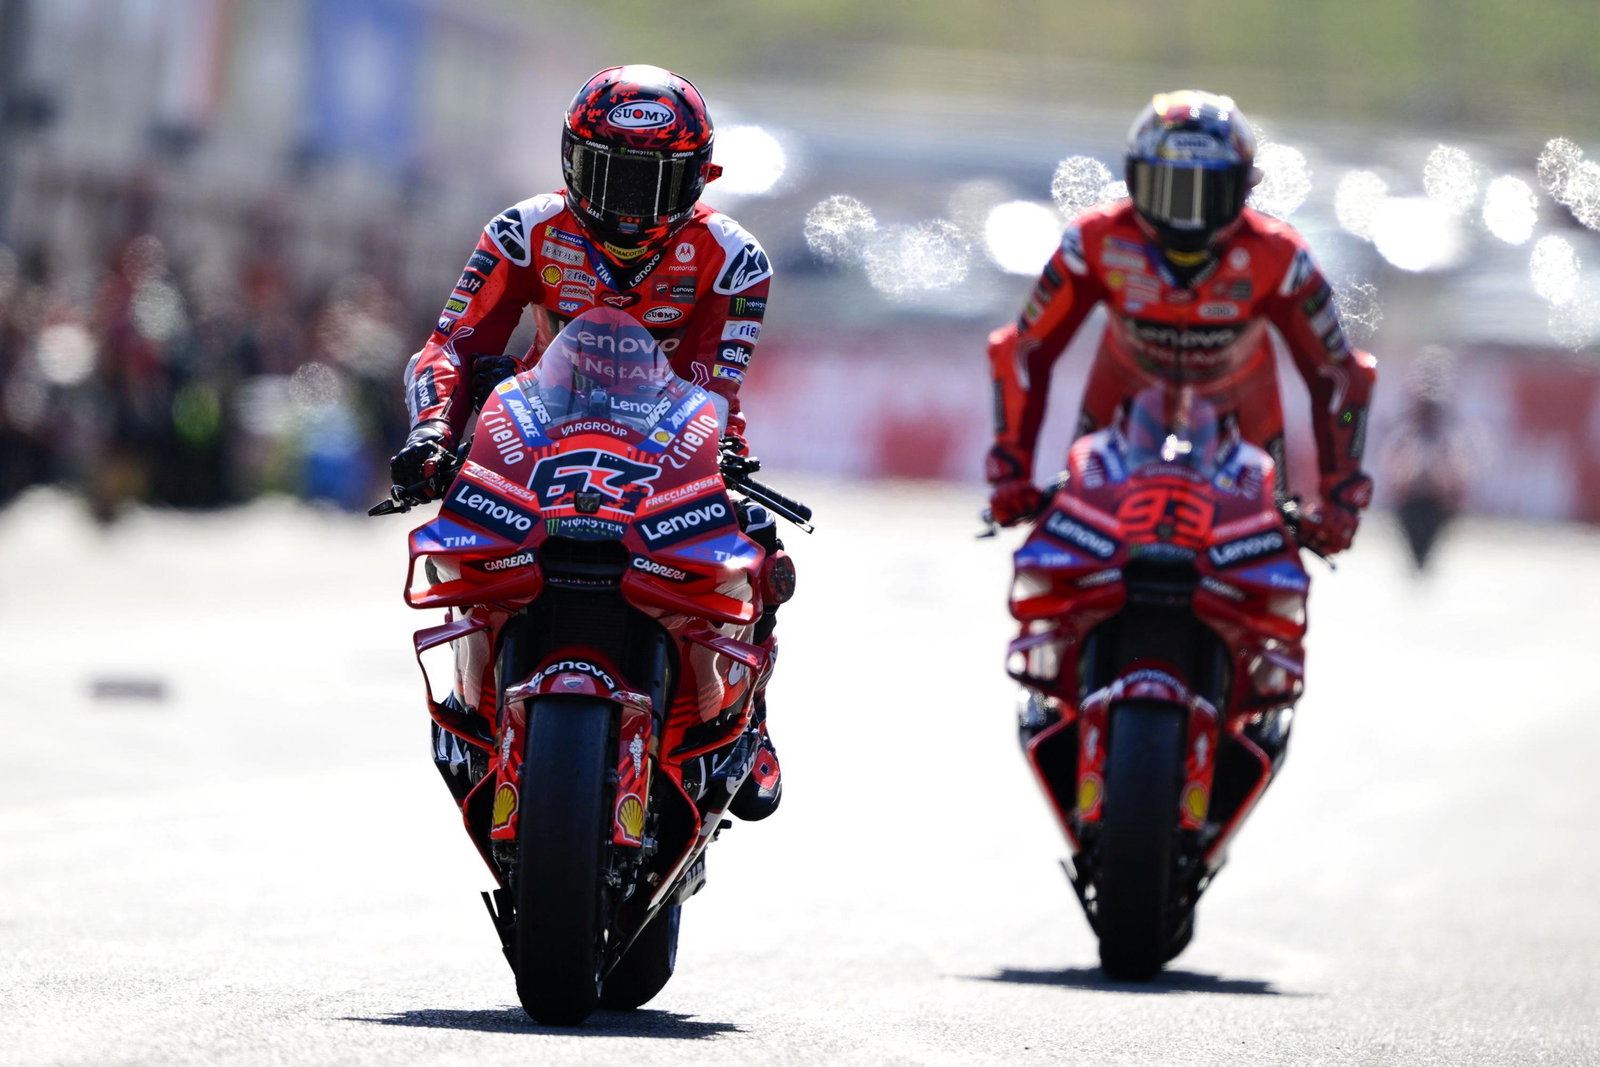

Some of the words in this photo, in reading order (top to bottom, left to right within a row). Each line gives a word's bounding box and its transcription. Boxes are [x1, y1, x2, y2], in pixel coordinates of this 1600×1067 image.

[615, 108, 669, 123] SUOMY
[585, 139, 609, 150] CARRERA
[596, 264, 612, 284] TIM
[629, 253, 660, 288] Lenovo
[558, 302, 578, 311] SAP
[558, 320, 680, 354] Lenovo
[722, 347, 751, 366] elic
[528, 396, 551, 425] WRS
[610, 396, 655, 414] Leno
[645, 396, 672, 428] WRS
[561, 421, 628, 437] VARGROUP
[526, 448, 662, 516] 63
[645, 476, 721, 508] FRECCIAROSSA
[455, 485, 532, 531] Lenovo
[1115, 487, 1217, 548] 93
[641, 503, 726, 541] Lenovo
[443, 535, 477, 547] TIM
[1208, 532, 1284, 566] Lenovo
[484, 553, 534, 571] CARRERA
[633, 557, 687, 581] CARRERA
